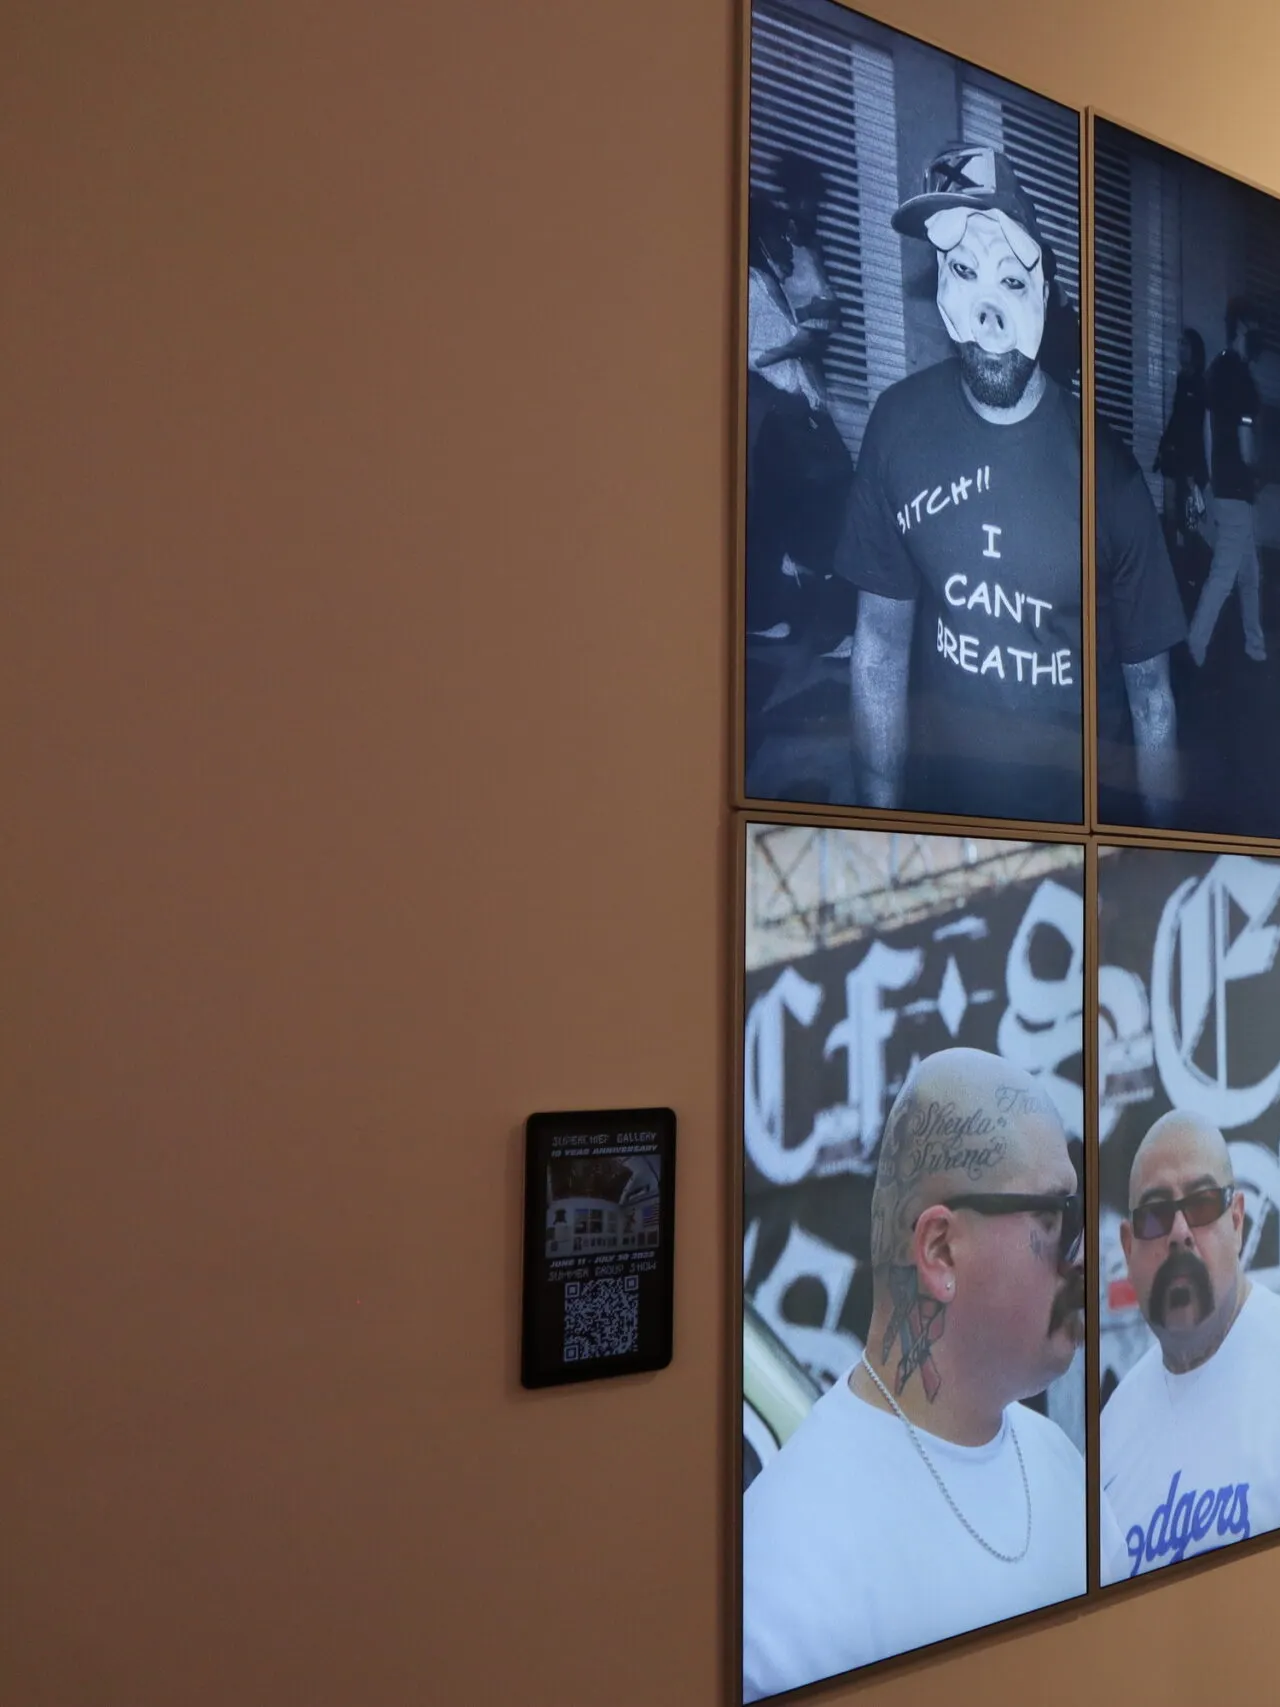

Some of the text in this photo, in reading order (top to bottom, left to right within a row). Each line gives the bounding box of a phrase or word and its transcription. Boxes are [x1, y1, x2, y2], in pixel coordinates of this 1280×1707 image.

[982, 523, 1002, 558] I
[944, 573, 1053, 628] CAN'T
[936, 617, 1073, 686] BREATHE
[616, 1131, 657, 1144] GALLERY
[551, 1144, 659, 1158] 10 YEAR ANNIVERSARY
[629, 1260, 658, 1273] SHOW
